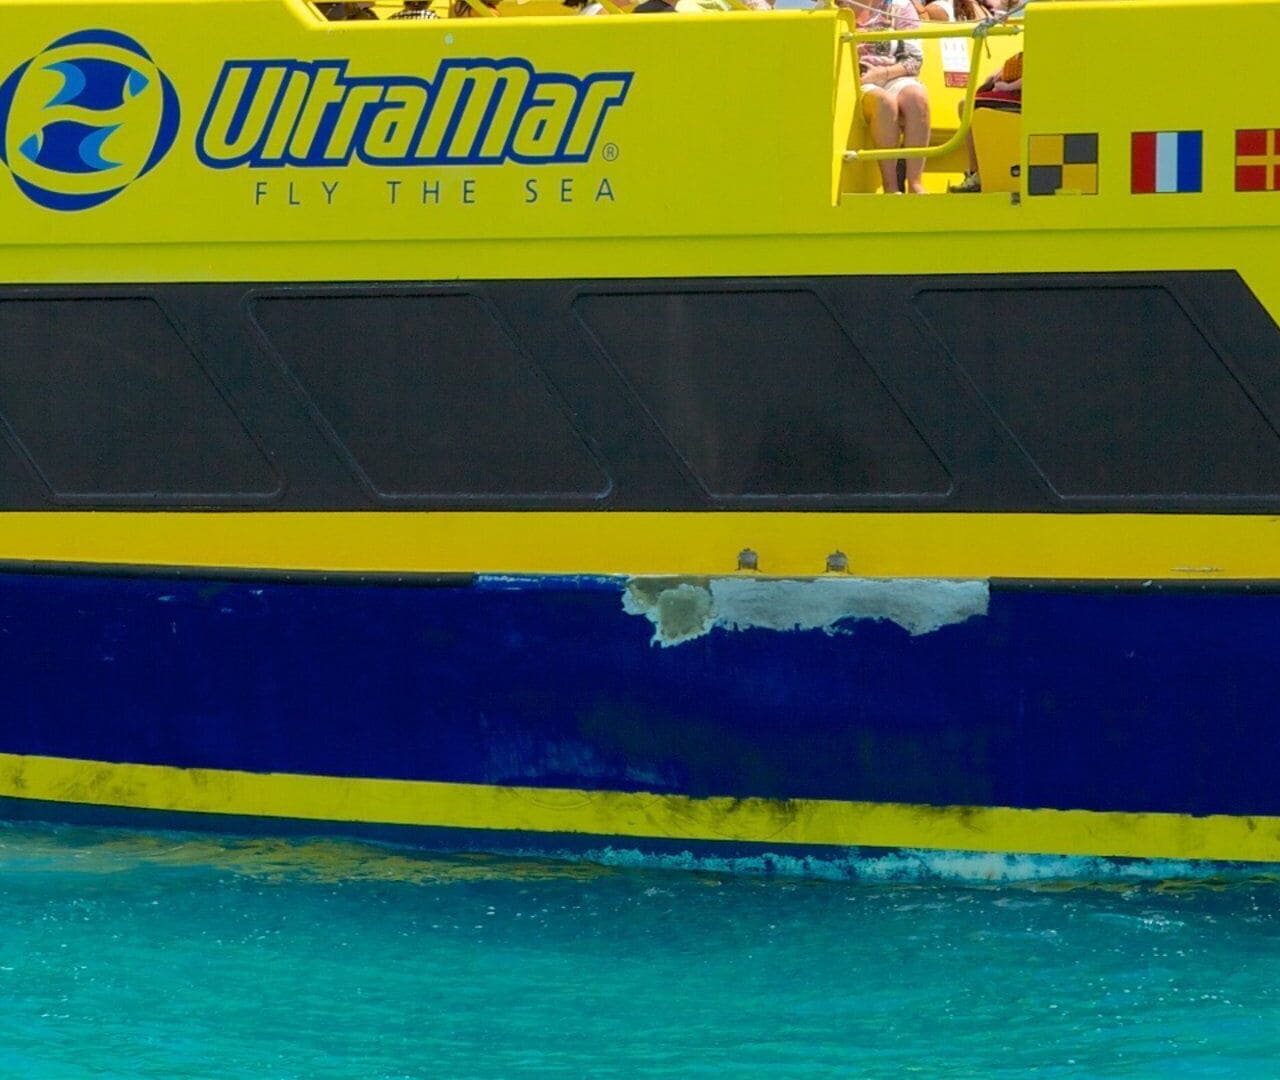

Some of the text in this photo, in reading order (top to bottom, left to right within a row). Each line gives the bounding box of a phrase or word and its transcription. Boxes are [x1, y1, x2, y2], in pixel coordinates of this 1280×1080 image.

[255, 178, 616, 205] FLY THE SEA
